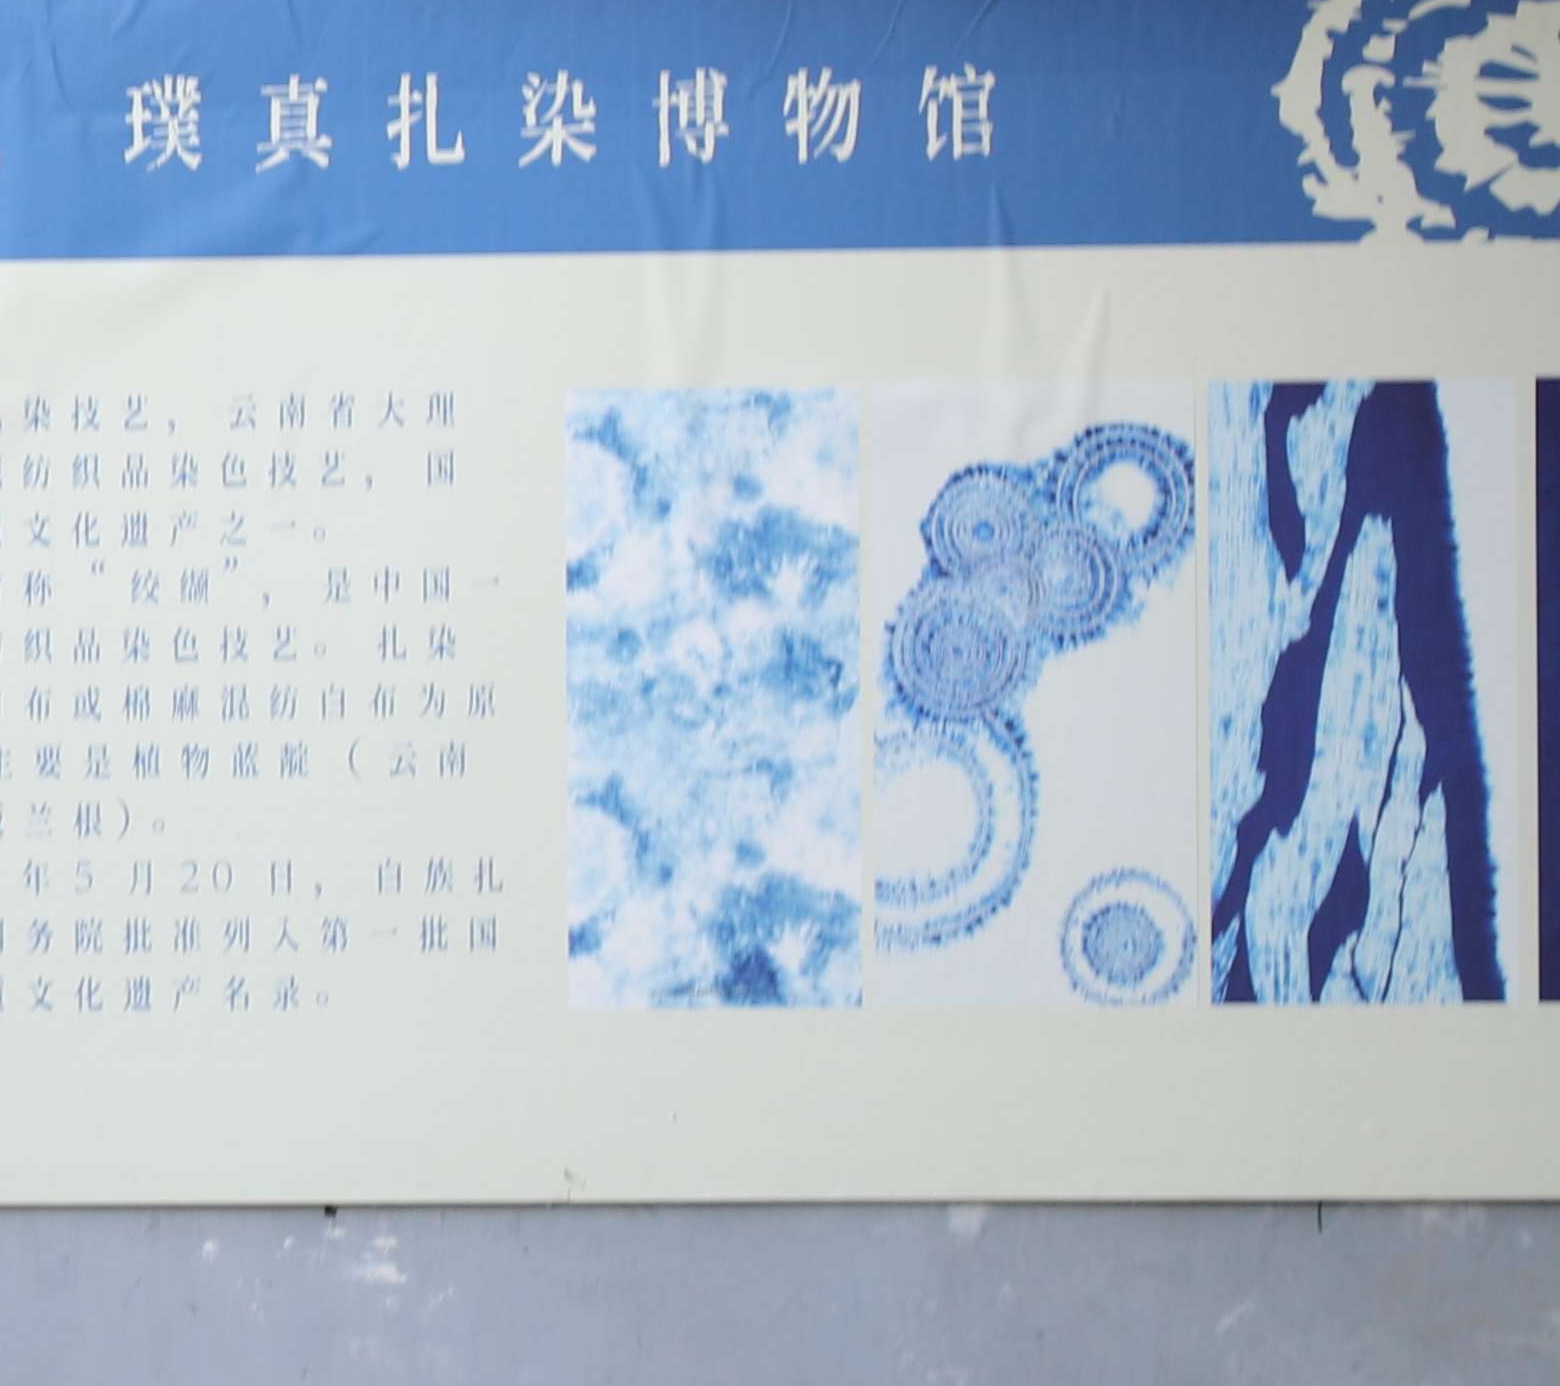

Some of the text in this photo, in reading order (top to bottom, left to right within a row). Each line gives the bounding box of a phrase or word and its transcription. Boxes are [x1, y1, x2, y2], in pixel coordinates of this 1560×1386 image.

[123, 65, 996, 172] 璞真扎染博物馆
